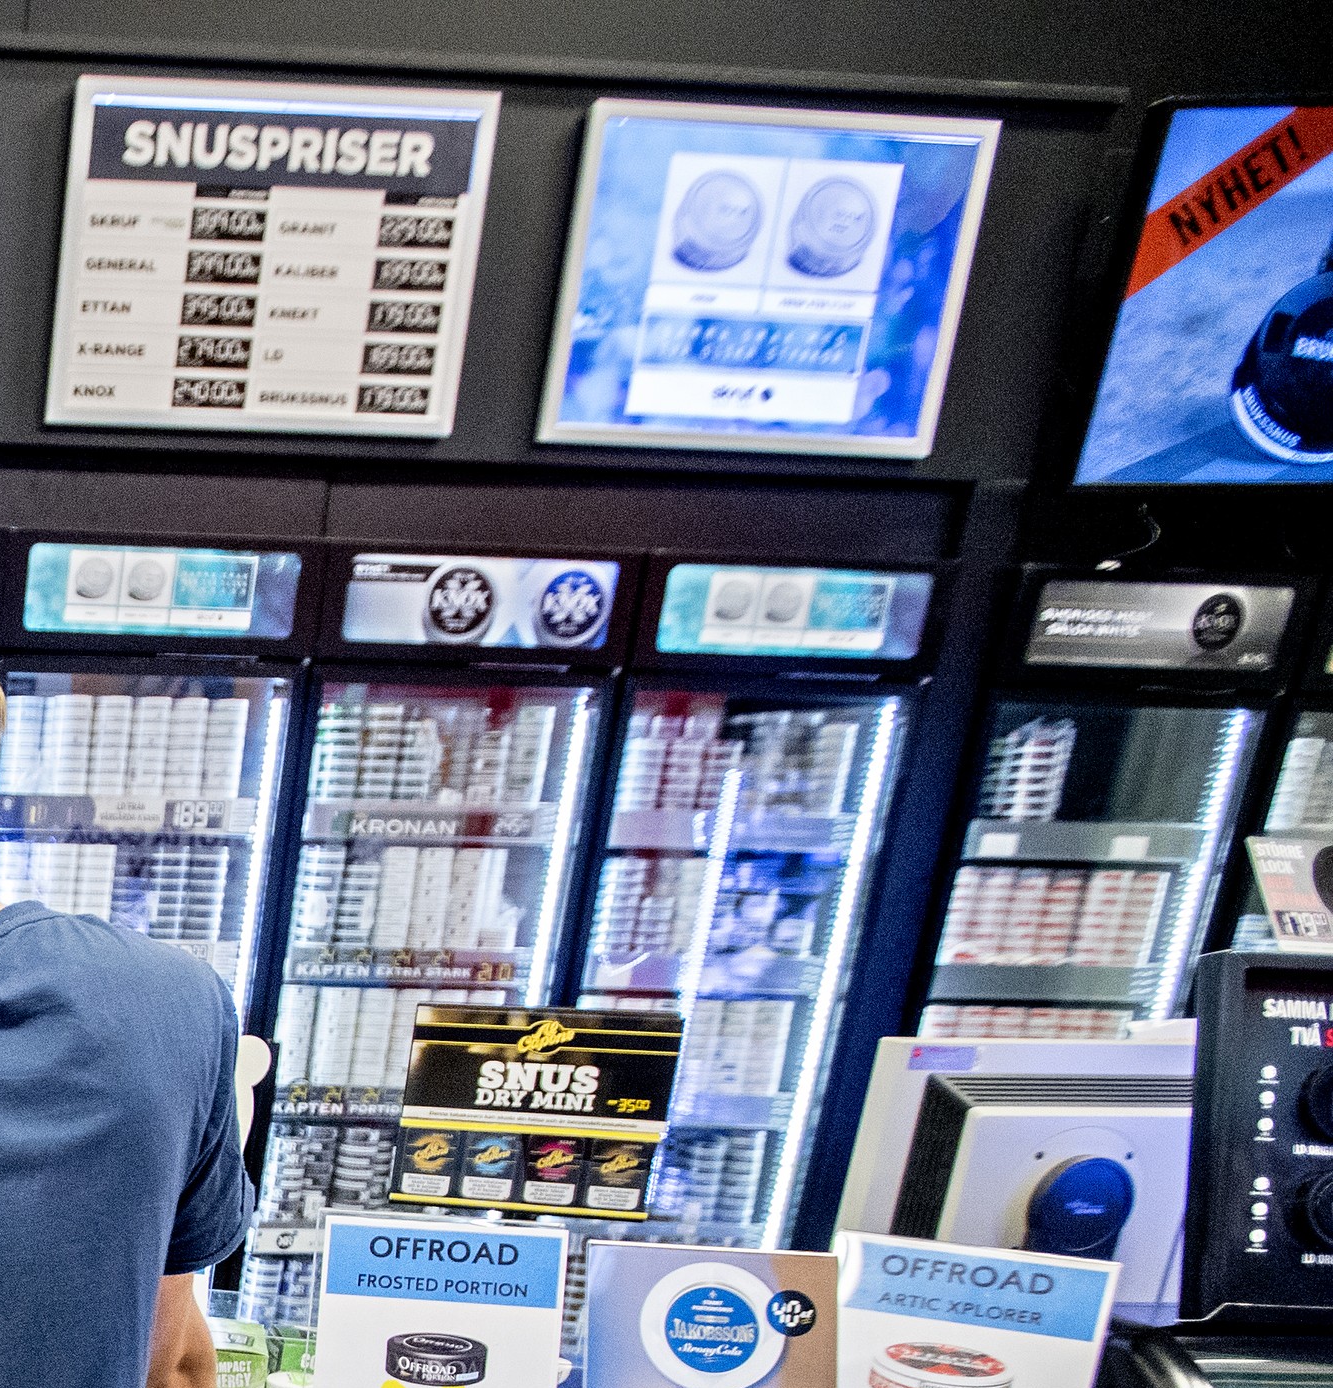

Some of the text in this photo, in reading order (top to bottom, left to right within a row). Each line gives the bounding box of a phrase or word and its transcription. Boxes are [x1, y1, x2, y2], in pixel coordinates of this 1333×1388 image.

[121, 120, 435, 178] SNUSPRISER
[1170, 124, 1309, 246] NYHET!
[86, 257, 156, 272] GENERAL
[81, 300, 131, 314] ETTAN
[78, 342, 146, 356] X-RANGE
[73, 385, 116, 398] KNOX
[350, 818, 458, 837] KRONAN
[1260, 859, 1295, 876] LOCK
[295, 964, 369, 977] KAPTEN
[375, 966, 421, 977] EXTRA
[1263, 999, 1326, 1020] SAMMA
[1290, 1024, 1321, 1047] TVÅ
[478, 1060, 600, 1095] SNUS
[273, 1102, 343, 1115] KAPTEN
[474, 1088, 597, 1112] DRY MINI
[369, 1235, 519, 1266] OFFROAD
[882, 1253, 1055, 1296] OFFROAD
[357, 1273, 529, 1298] FROSTED PORTION
[878, 1291, 1042, 1326] ARTIC XPLORER
[398, 1356, 457, 1375] OFFROAD
